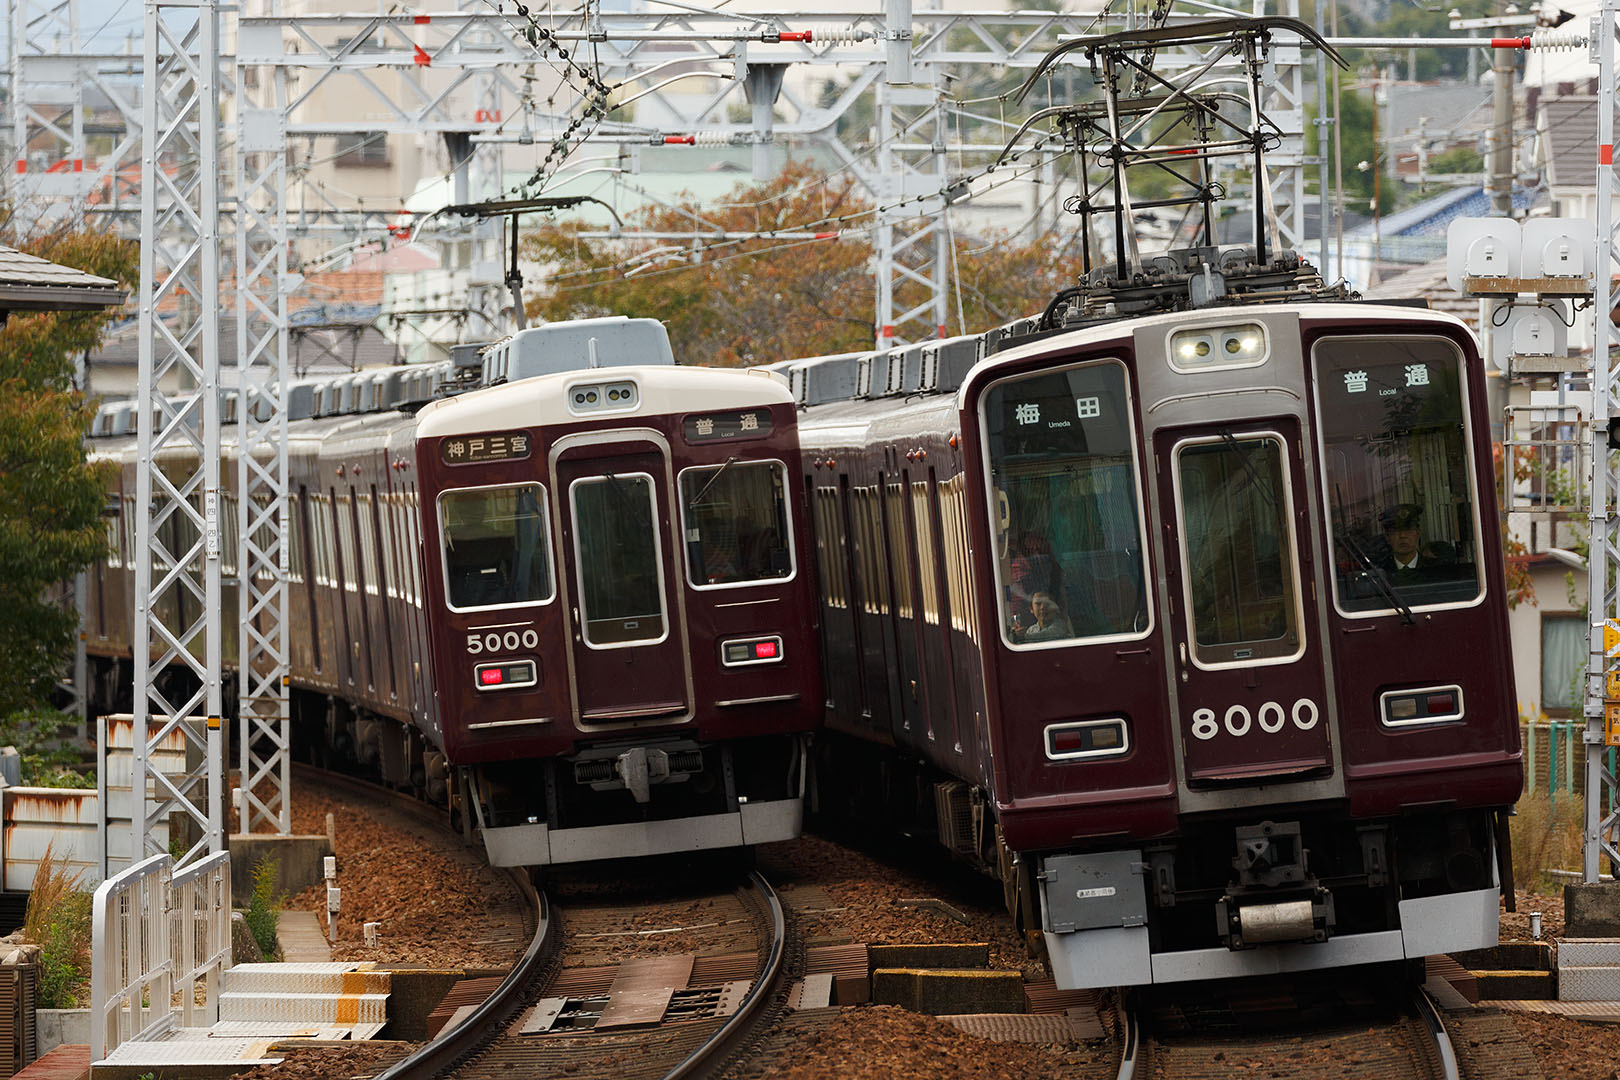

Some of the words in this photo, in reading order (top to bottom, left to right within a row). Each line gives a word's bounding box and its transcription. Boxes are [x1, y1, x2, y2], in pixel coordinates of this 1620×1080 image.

[1344, 363, 1430, 393] 普通
[1379, 387, 1397, 396] Local
[1015, 396, 1100, 426] 梅田
[696, 413, 759, 435] 普通
[1048, 420, 1071, 429] Umeda
[447, 436, 527, 458] 神戸三宮
[466, 629, 539, 655] 5000
[1191, 698, 1319, 740] 8000
